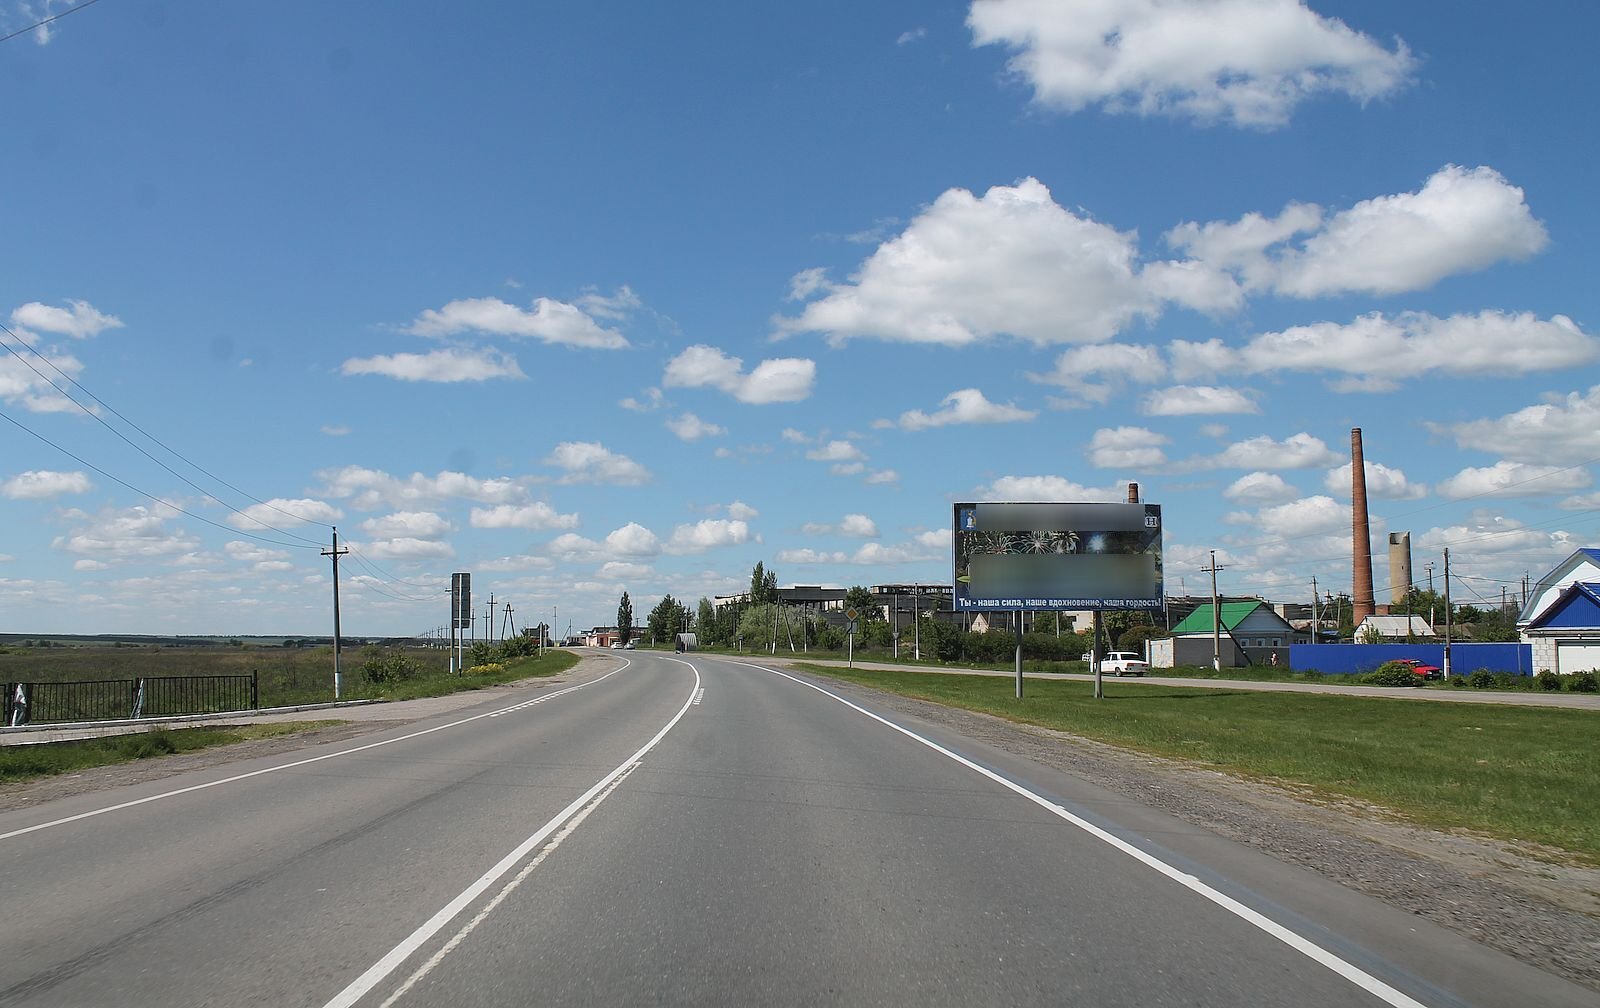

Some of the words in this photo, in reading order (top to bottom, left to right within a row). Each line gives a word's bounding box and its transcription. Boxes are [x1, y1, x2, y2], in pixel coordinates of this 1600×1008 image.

[959, 598, 971, 607] Ты
[978, 599, 1000, 607] наша
[1001, 599, 1024, 608] сила,
[1025, 599, 1047, 607] наше
[1048, 599, 1102, 608] вдохновение,
[1103, 599, 1125, 607] наша
[1126, 598, 1161, 608] гордость!
